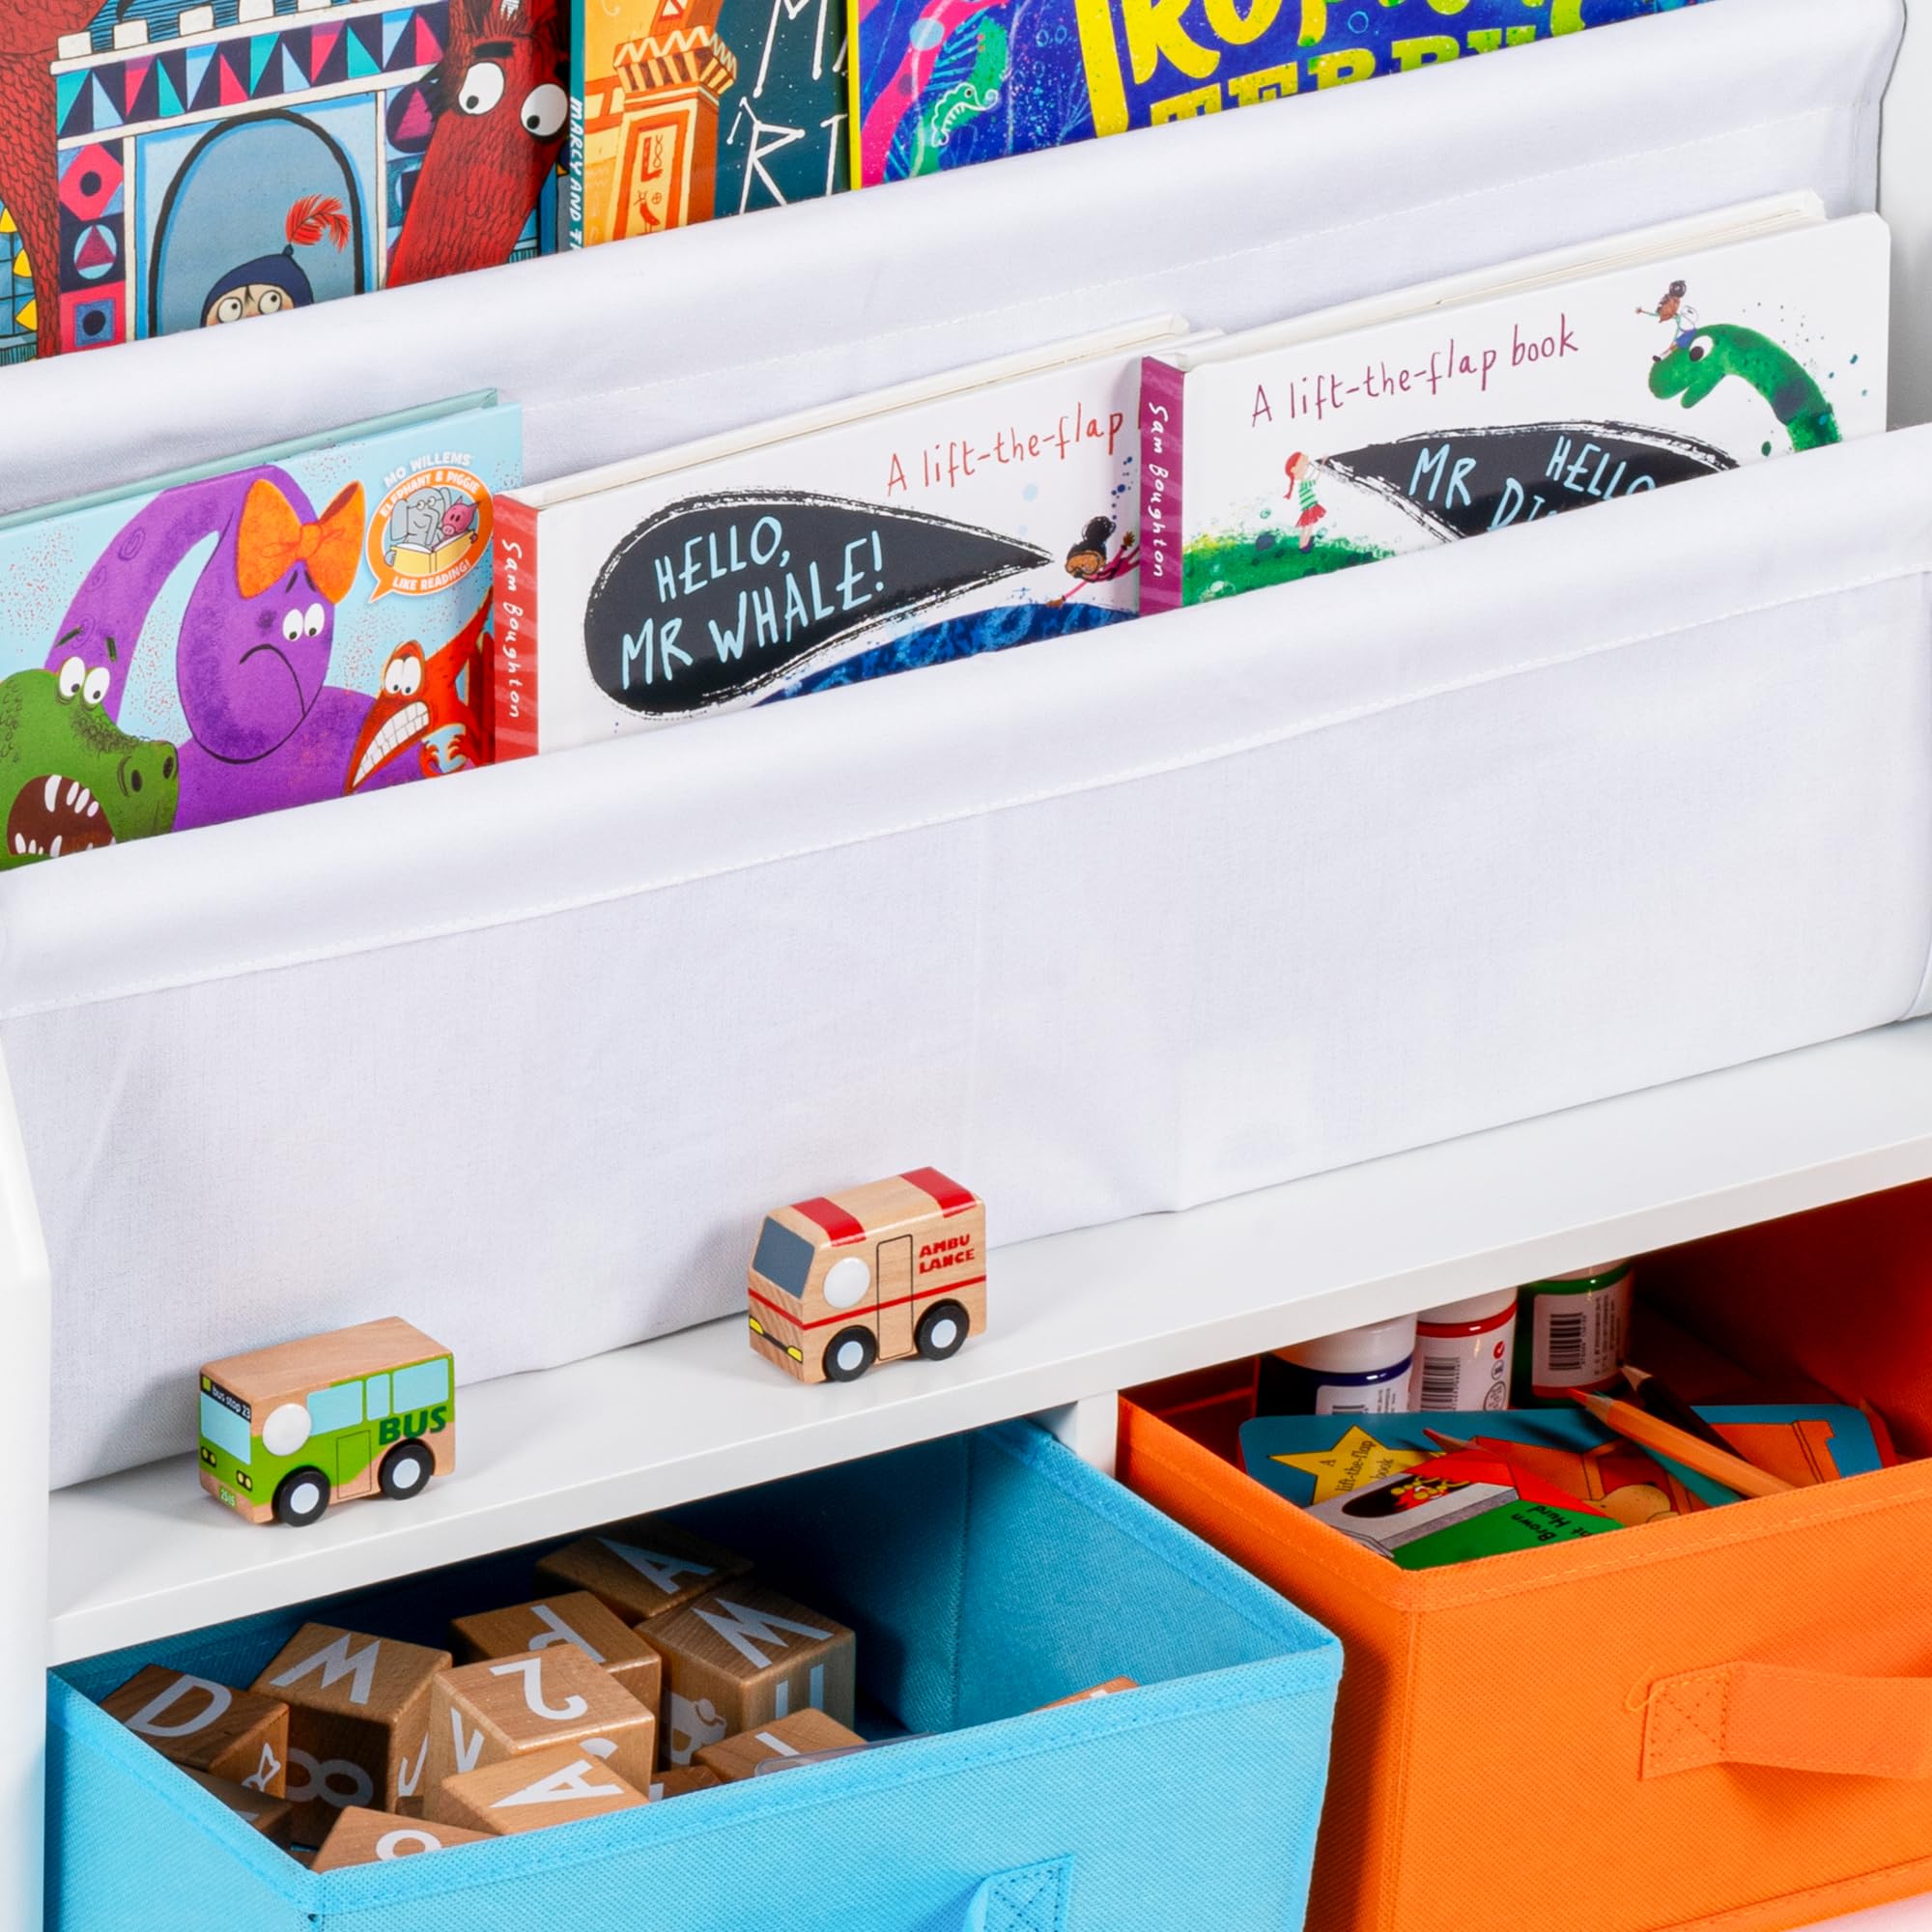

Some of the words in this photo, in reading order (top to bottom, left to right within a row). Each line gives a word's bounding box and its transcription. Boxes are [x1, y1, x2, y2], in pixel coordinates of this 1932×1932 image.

[569, 96, 584, 176] MARCY
[570, 177, 583, 222] AND
[1252, 384, 1272, 428] A
[1291, 339, 1498, 420] lift-the-flap
[1512, 312, 1579, 366] book
[887, 452, 907, 497] A
[923, 402, 1123, 488] lift-the-flap
[1148, 402, 1169, 454] Sam
[379, 473, 433, 518] ELEPHANT
[445, 469, 481, 496] PIGGIE
[383, 465, 408, 489] MO
[409, 451, 472, 472] WILLEMS
[1407, 443, 1477, 509] MR
[1148, 463, 1169, 577] Boughton
[391, 575, 417, 591] LIKE
[419, 558, 471, 591] READING!
[501, 538, 523, 592] Sam
[654, 516, 790, 603] HELLO,
[621, 617, 694, 691] MR
[707, 529, 885, 663] WHALE!
[502, 601, 524, 719] Boughton
[919, 1233, 971, 1259] AMBU
[919, 1248, 975, 1274] LANCE
[378, 1406, 447, 1446] BUS
[127, 1674, 233, 1738] D
[488, 1758, 624, 1808] A
